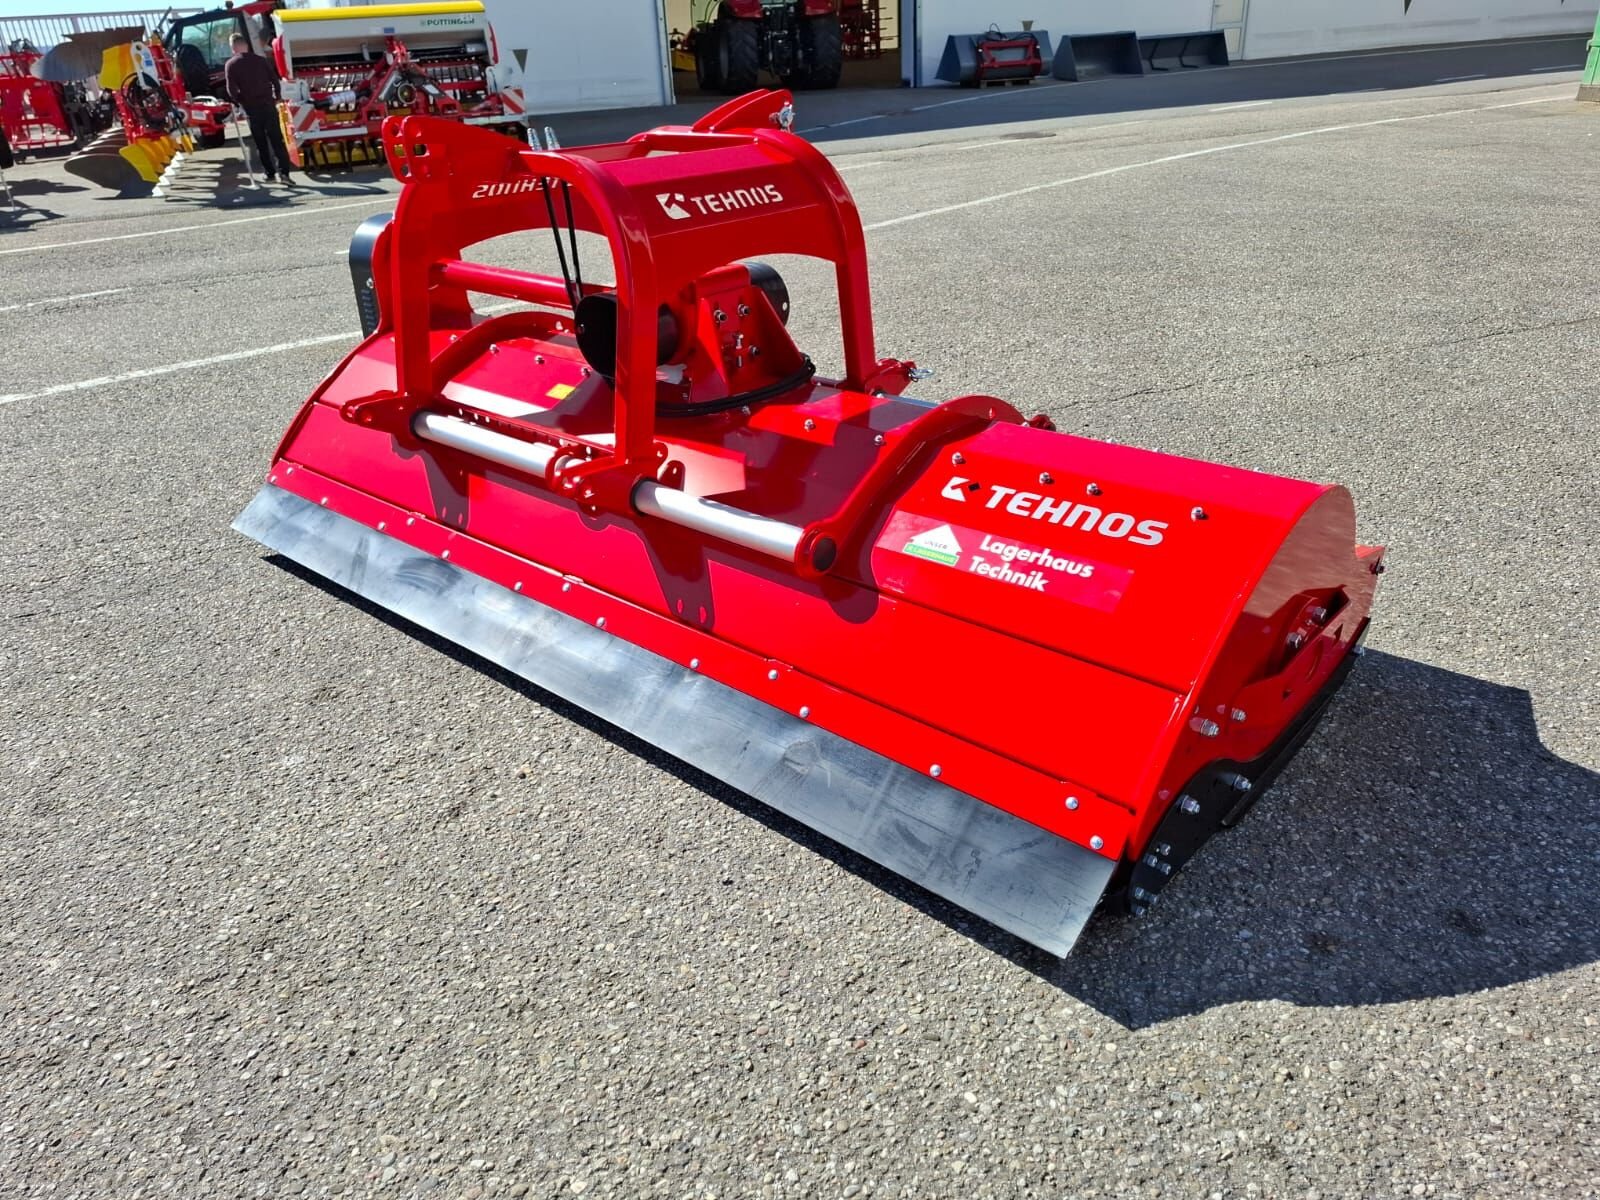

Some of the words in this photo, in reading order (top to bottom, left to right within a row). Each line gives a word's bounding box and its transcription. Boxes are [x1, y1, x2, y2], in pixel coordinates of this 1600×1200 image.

[690, 184, 783, 215] TEHNOS
[985, 485, 1169, 546] TEHNOS
[968, 556, 1050, 592] Technik
[980, 535, 1095, 578] Lagerhaus
